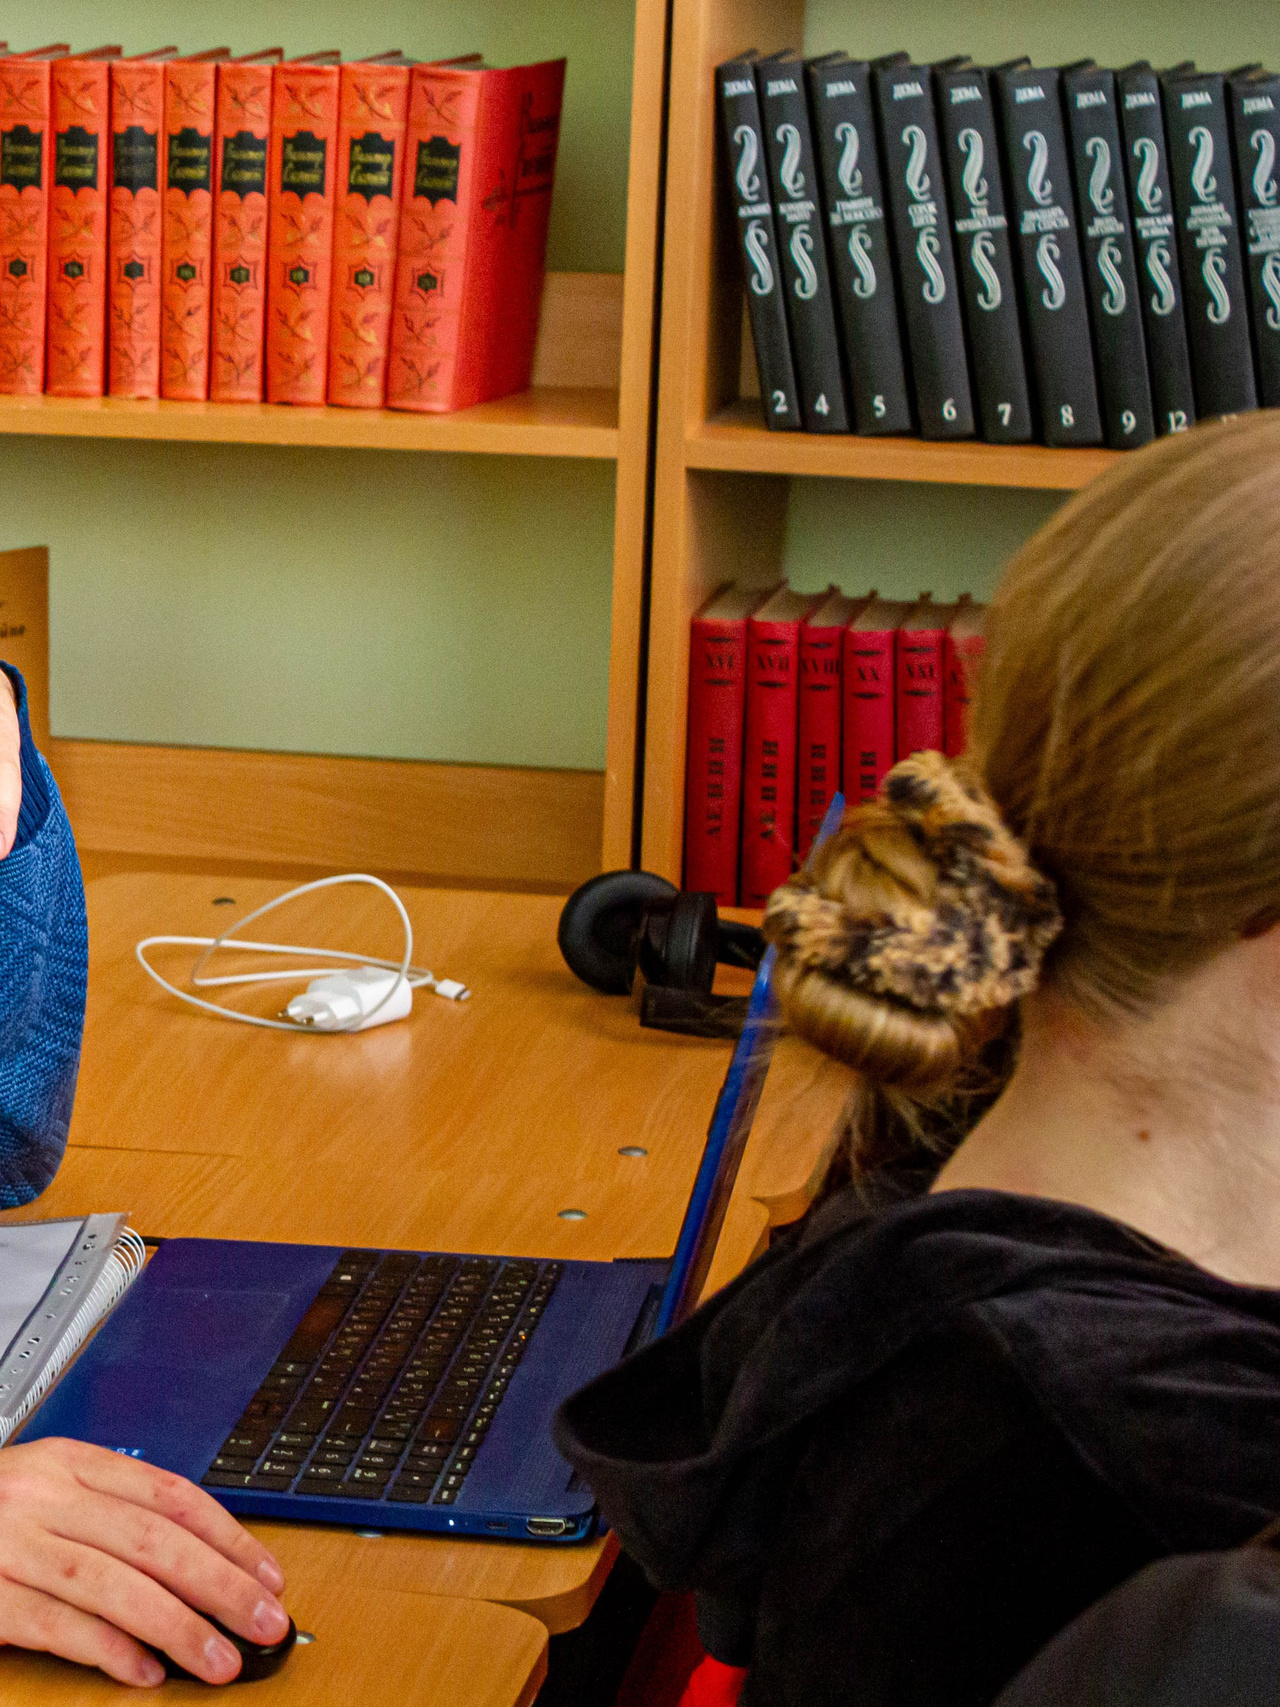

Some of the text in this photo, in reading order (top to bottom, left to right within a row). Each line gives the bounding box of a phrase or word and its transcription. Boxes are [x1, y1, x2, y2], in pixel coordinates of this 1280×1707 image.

[773, 390, 788, 413] 2
[815, 393, 830, 415] 4
[873, 394, 886, 418] 5
[942, 399, 957, 421] 6
[998, 403, 1011, 426] 7
[1061, 404, 1075, 427] 8
[1121, 410, 1137, 434] 9
[1167, 410, 1188, 433] 12
